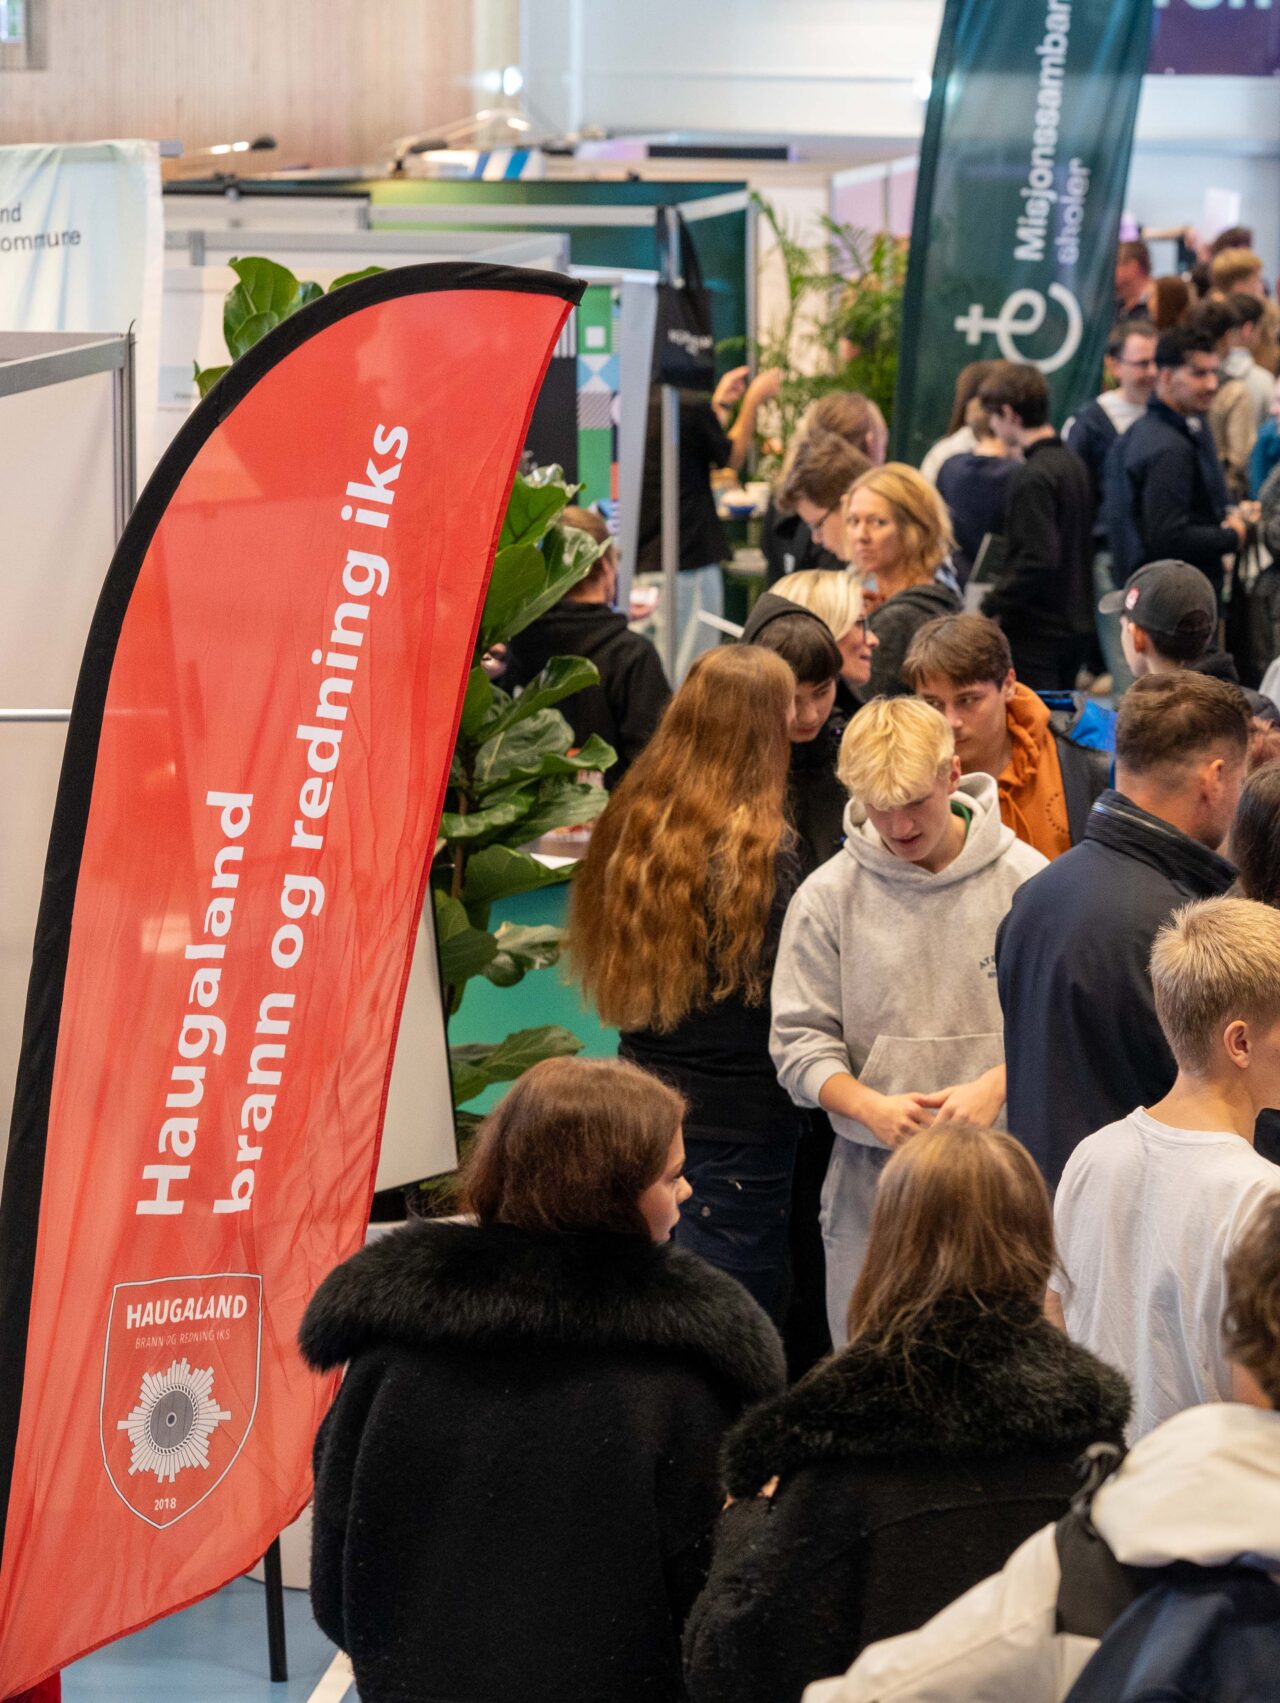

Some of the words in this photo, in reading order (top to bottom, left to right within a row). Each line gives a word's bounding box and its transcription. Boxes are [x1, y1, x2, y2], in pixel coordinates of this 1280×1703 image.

[340, 422, 409, 529] iks
[290, 548, 390, 850] redning
[270, 873, 326, 969] og
[135, 790, 254, 1216] Haugaland
[212, 991, 296, 1214] brann
[126, 1294, 248, 1330] HAUGALAND
[135, 1335, 164, 1350] BRANN
[165, 1334, 177, 1345] OG
[180, 1329, 215, 1345] REDNING
[216, 1328, 231, 1341] IKS
[154, 1497, 177, 1511] 2018
